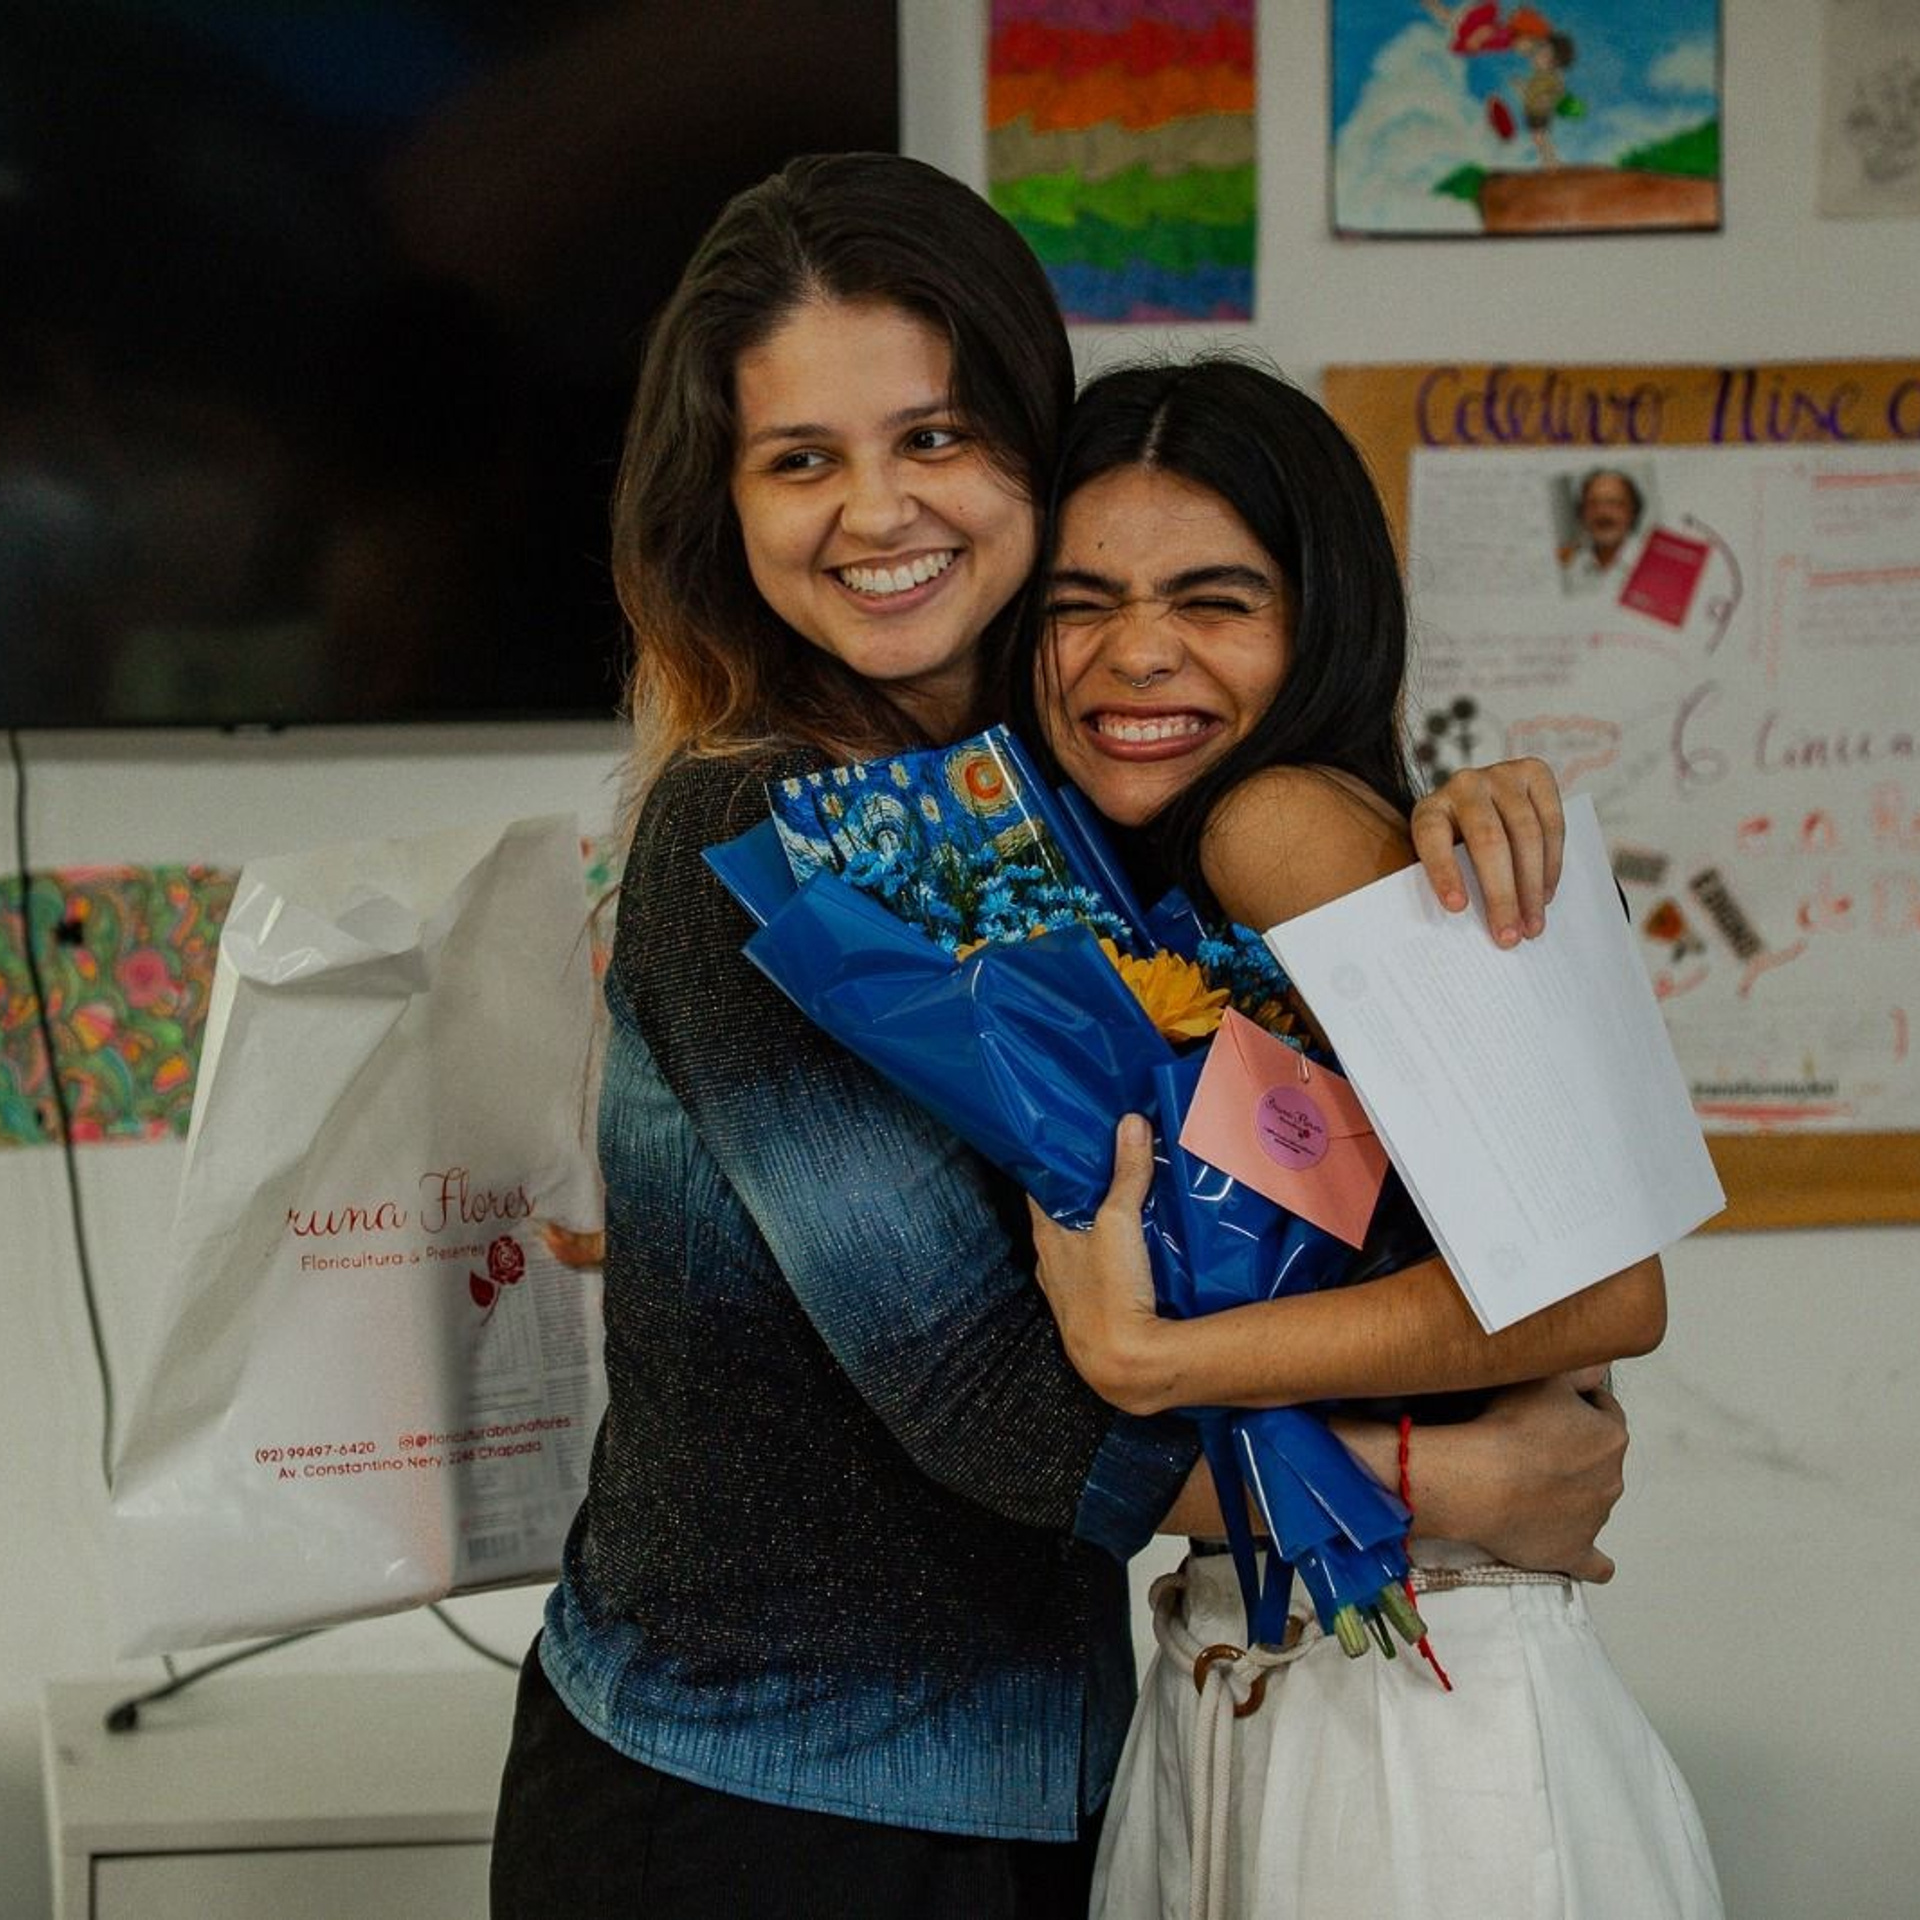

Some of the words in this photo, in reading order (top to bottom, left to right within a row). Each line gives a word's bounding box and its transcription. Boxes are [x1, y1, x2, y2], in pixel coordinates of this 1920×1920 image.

[419, 1166, 537, 1234] Flores
[301, 1251, 404, 1271] Floricultura
[255, 1447, 283, 1464] (92)
[287, 1442, 375, 1458] 99497-6420
[303, 1459, 404, 1477] Constantino
